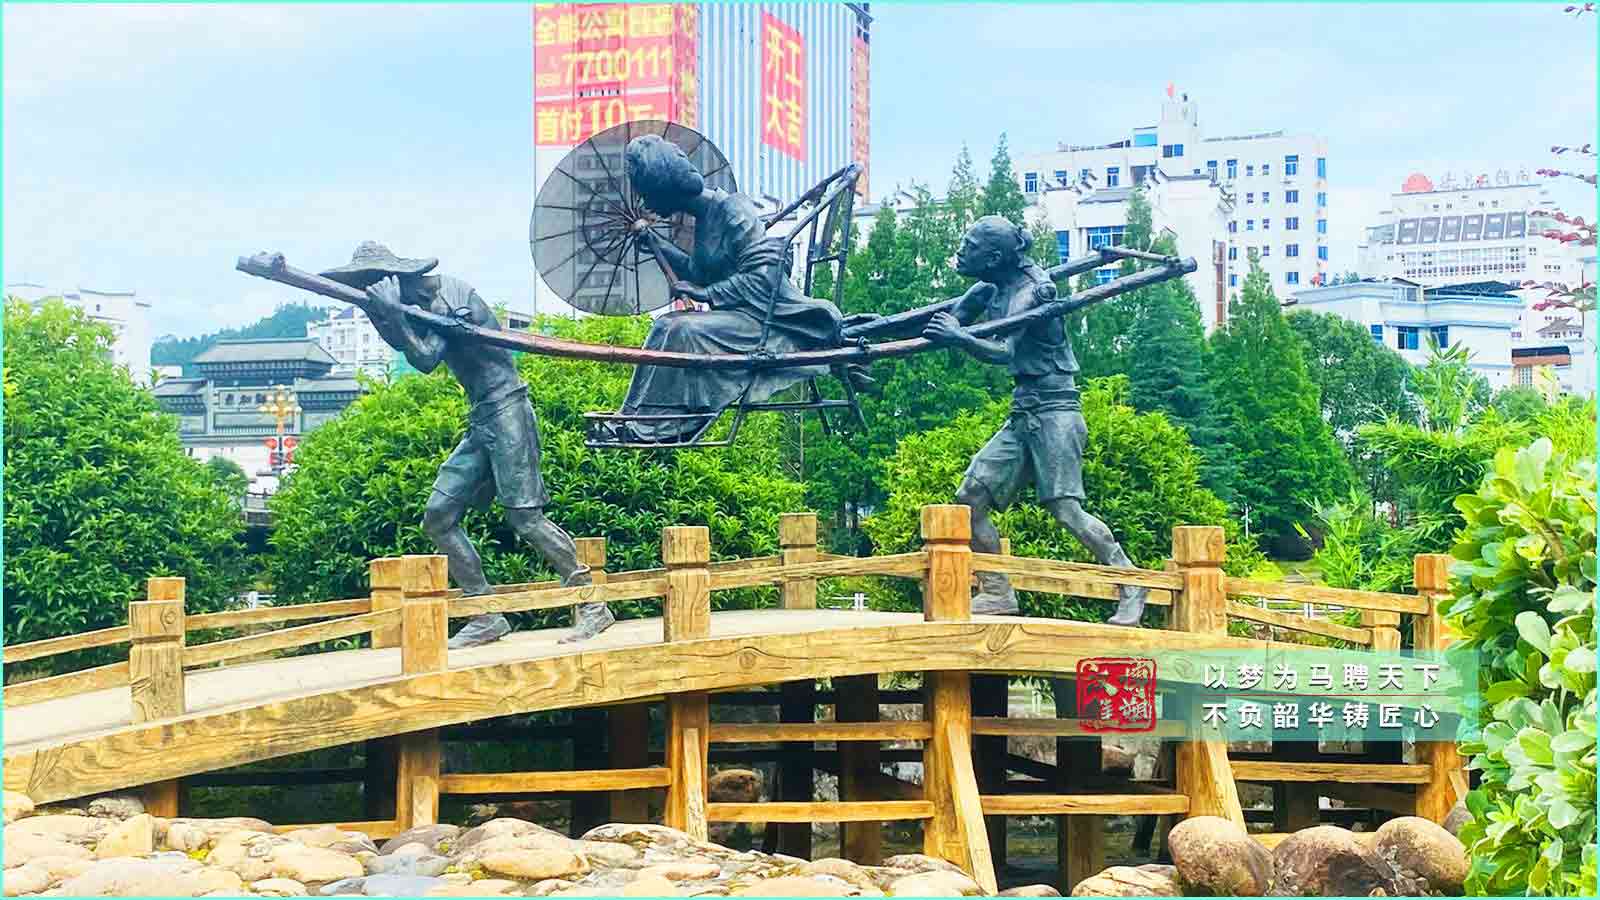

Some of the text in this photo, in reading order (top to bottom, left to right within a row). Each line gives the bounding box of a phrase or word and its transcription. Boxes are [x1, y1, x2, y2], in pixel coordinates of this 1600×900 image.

[562, 47, 672, 83] 7700111
[767, 24, 801, 87] 开工
[537, 98, 668, 144] 首付10
[767, 84, 801, 147] 大吉
